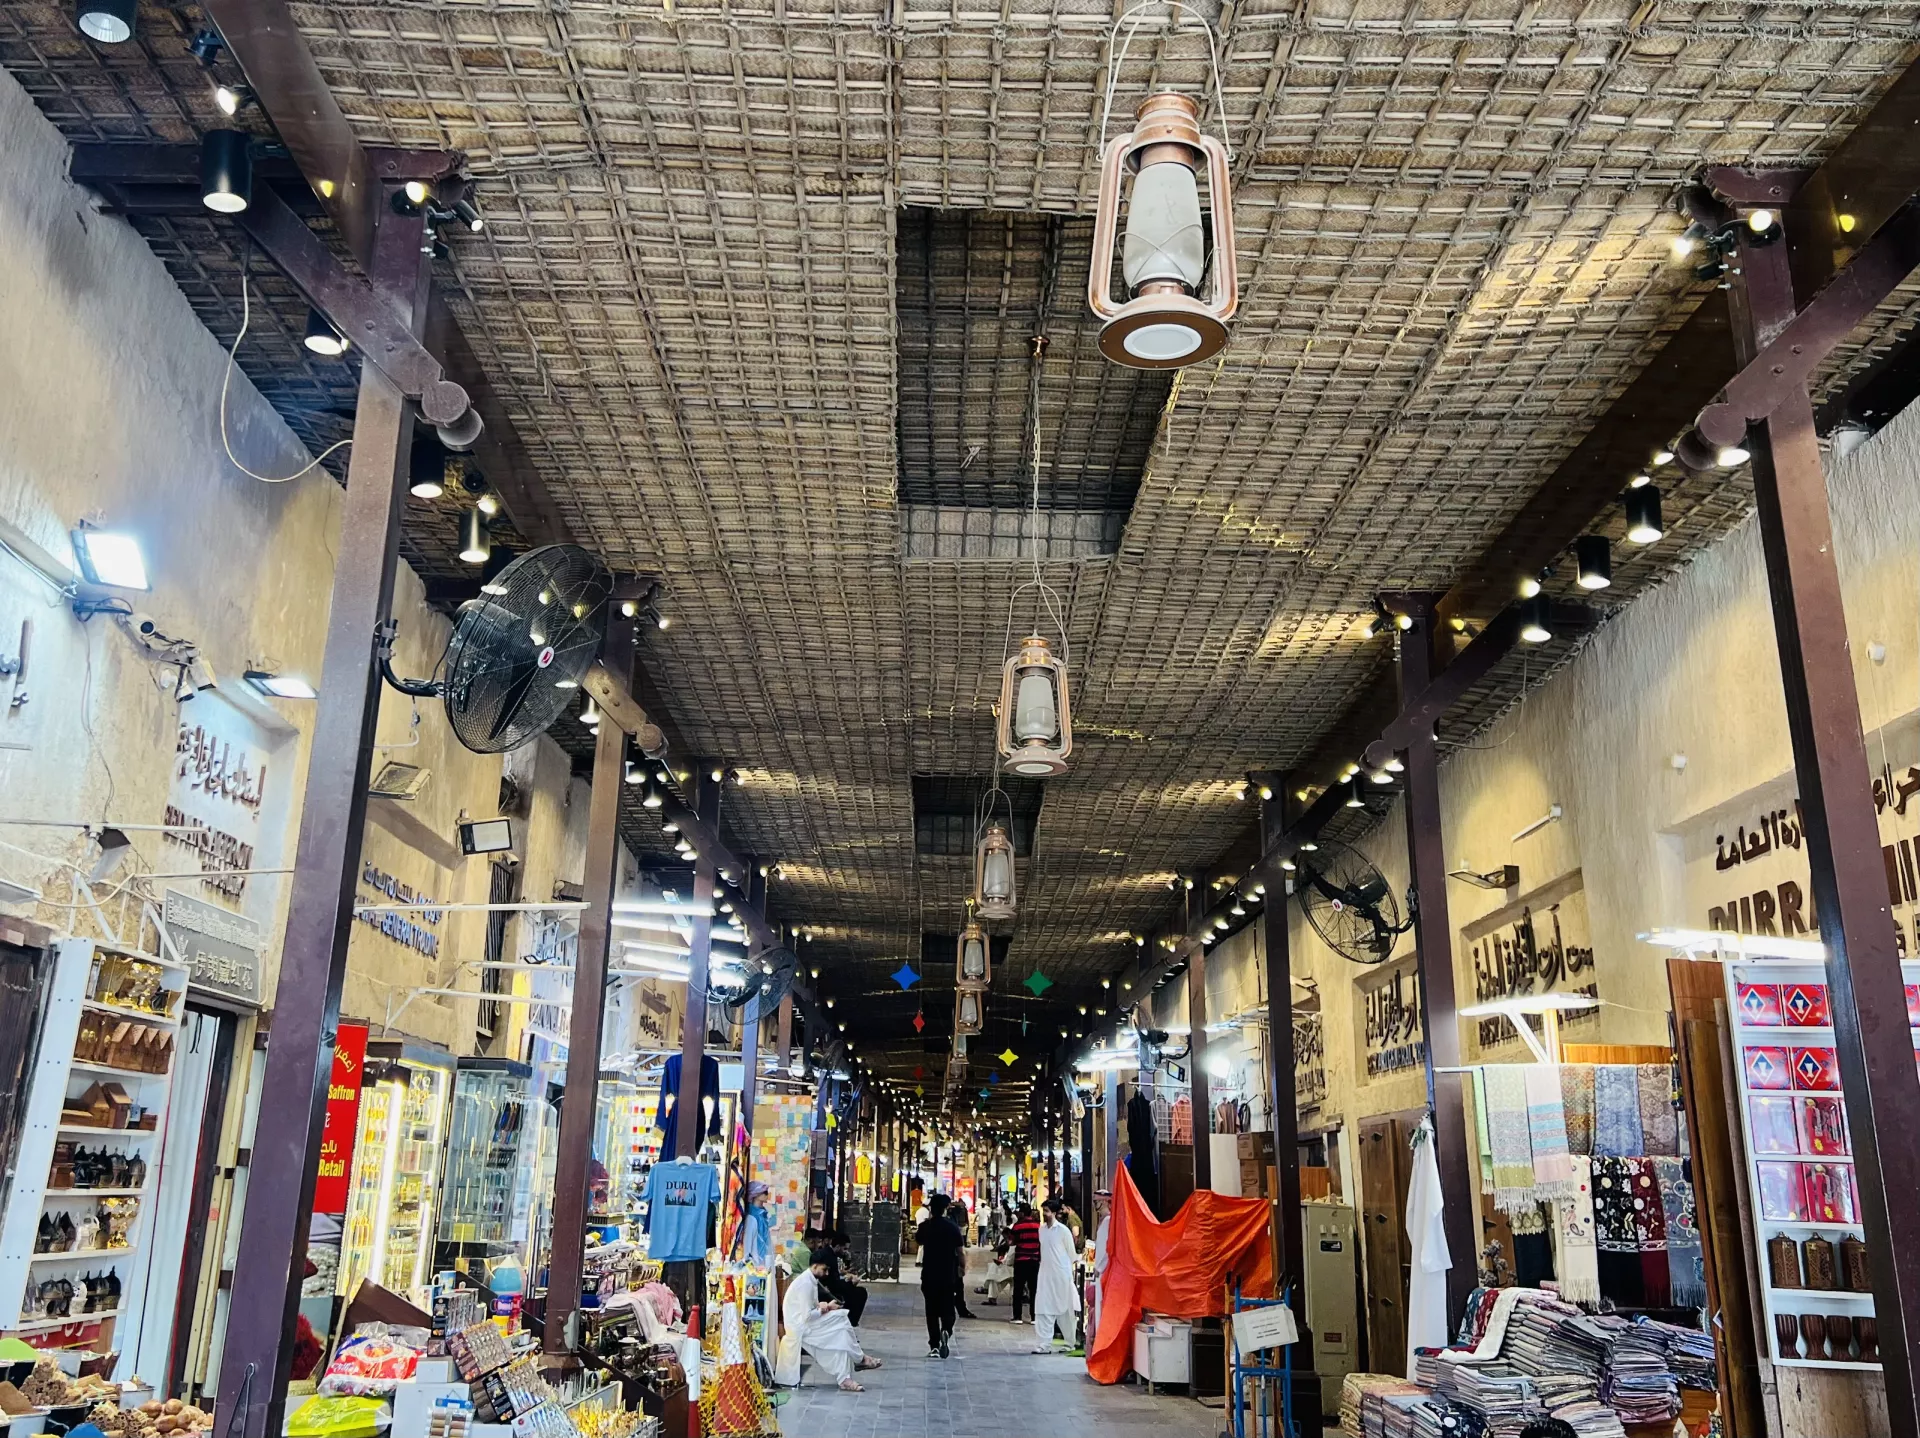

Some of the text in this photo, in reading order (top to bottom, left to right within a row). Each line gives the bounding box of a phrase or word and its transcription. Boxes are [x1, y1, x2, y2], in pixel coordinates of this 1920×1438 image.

[334, 1044, 357, 1072] زعفرا
[328, 1083, 355, 1101] Saffron
[317, 1159, 345, 1177] Retail
[666, 1180, 698, 1191] DUBAI
